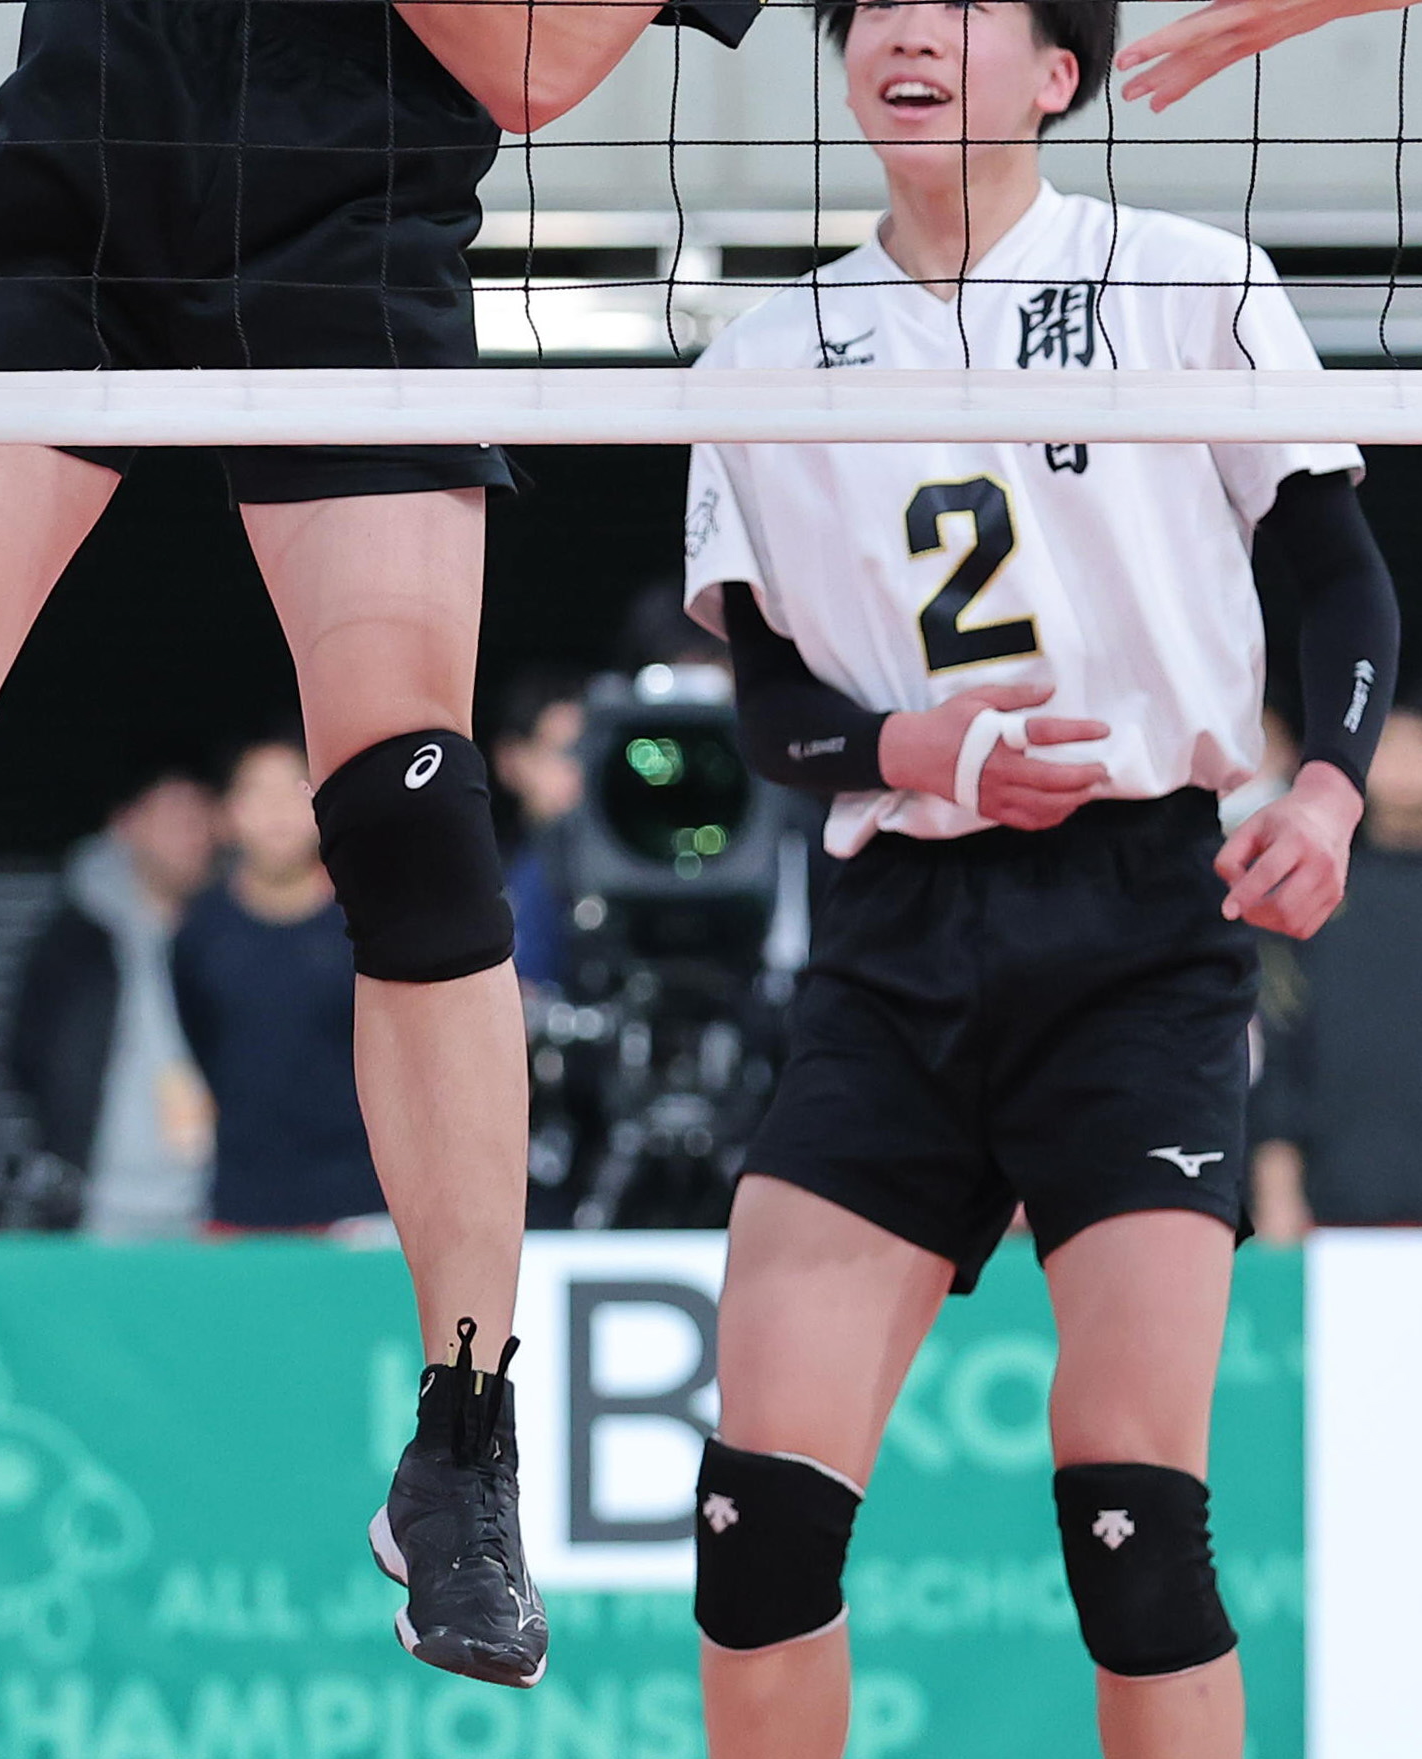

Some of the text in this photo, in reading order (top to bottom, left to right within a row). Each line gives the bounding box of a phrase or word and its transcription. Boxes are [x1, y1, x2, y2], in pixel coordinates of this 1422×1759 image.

[905, 472, 1042, 676] 2
[153, 1560, 309, 1638] ALL
[850, 1556, 1080, 1633] SCHO
